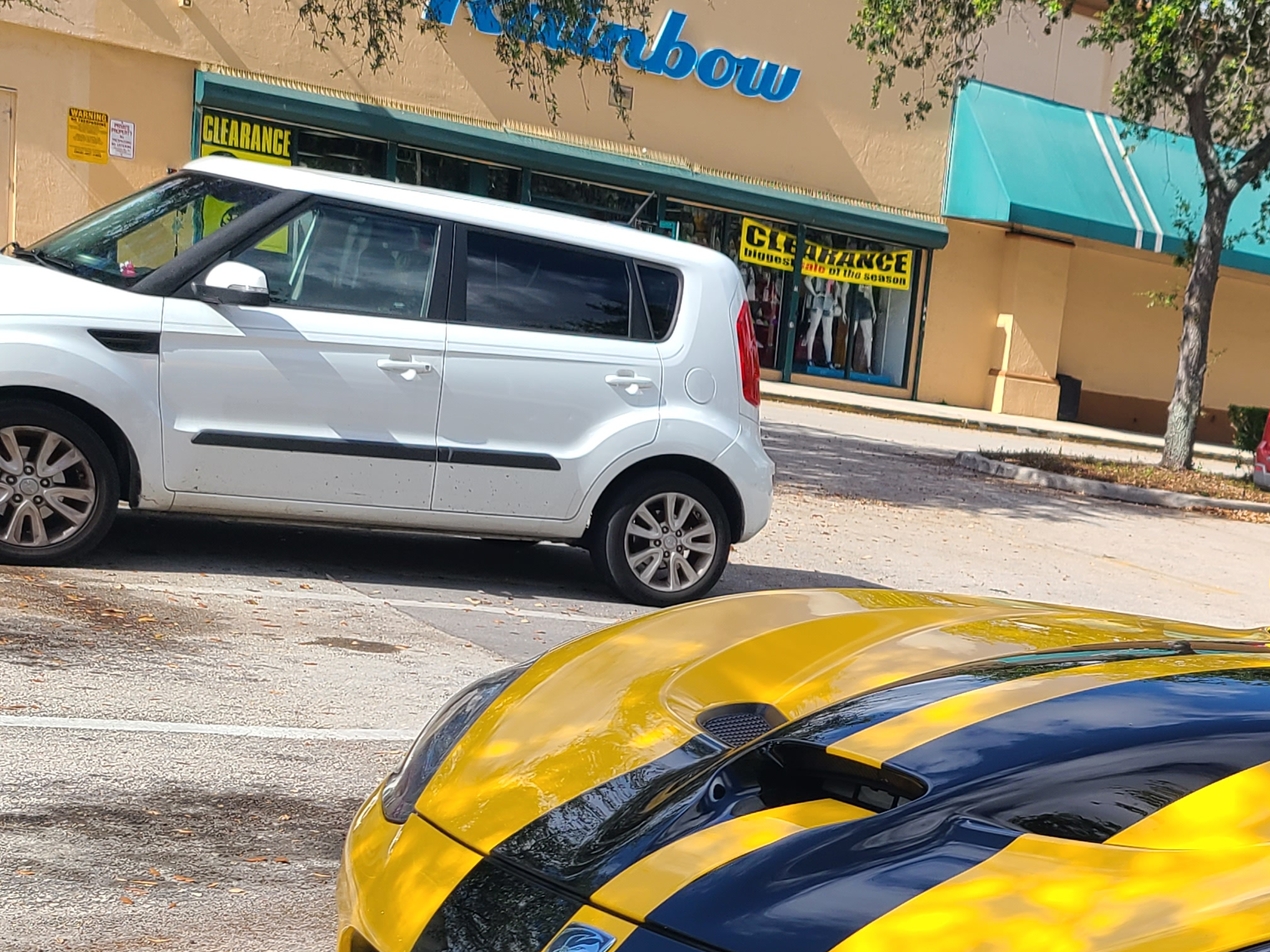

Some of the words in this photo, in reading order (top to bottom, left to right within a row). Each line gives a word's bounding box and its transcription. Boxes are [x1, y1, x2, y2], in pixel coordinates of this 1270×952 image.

[70, 108, 107, 122] WARNING
[203, 114, 291, 157] CLEARANCE
[828, 266, 840, 276] of
[843, 268, 861, 279] the
[863, 273, 906, 286] season
